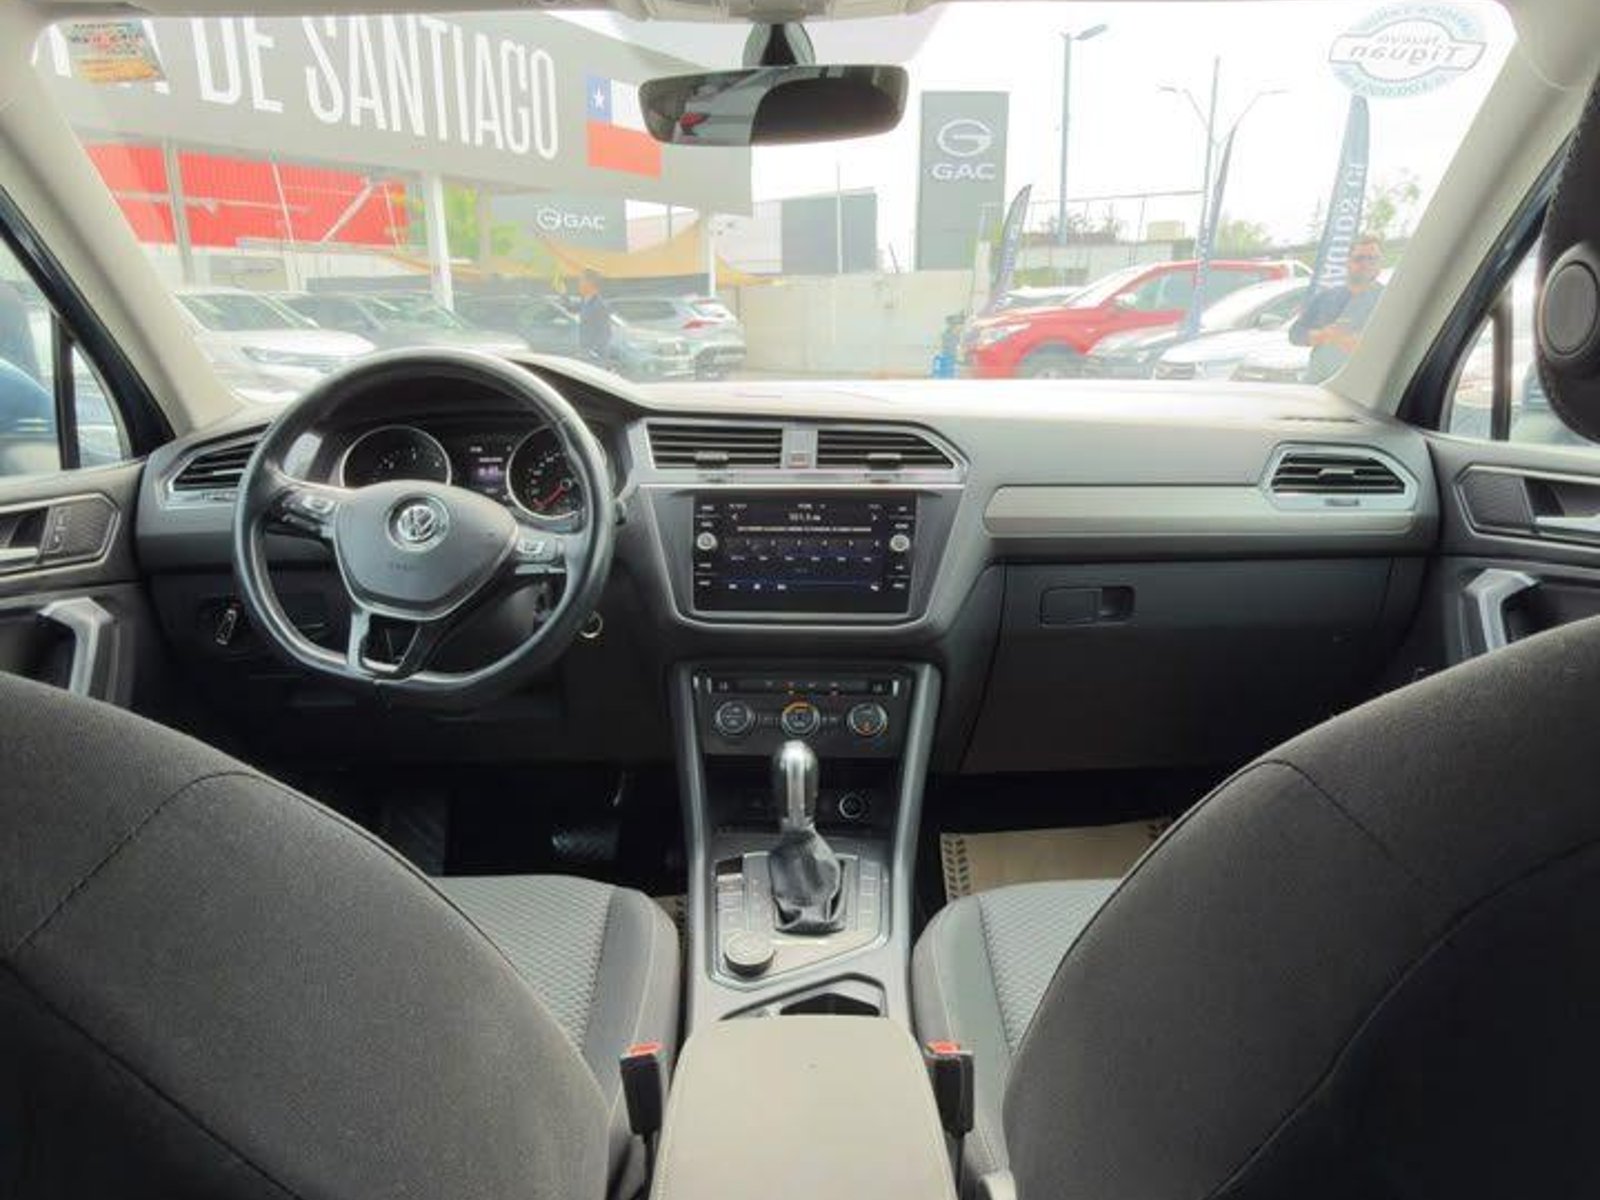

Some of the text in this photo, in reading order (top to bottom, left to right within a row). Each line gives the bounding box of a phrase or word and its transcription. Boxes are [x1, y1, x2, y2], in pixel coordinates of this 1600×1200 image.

[191, 16, 284, 113] DE
[301, 13, 559, 160] SANTIAGO
[932, 163, 996, 179] GAC
[563, 212, 606, 231] GAC
